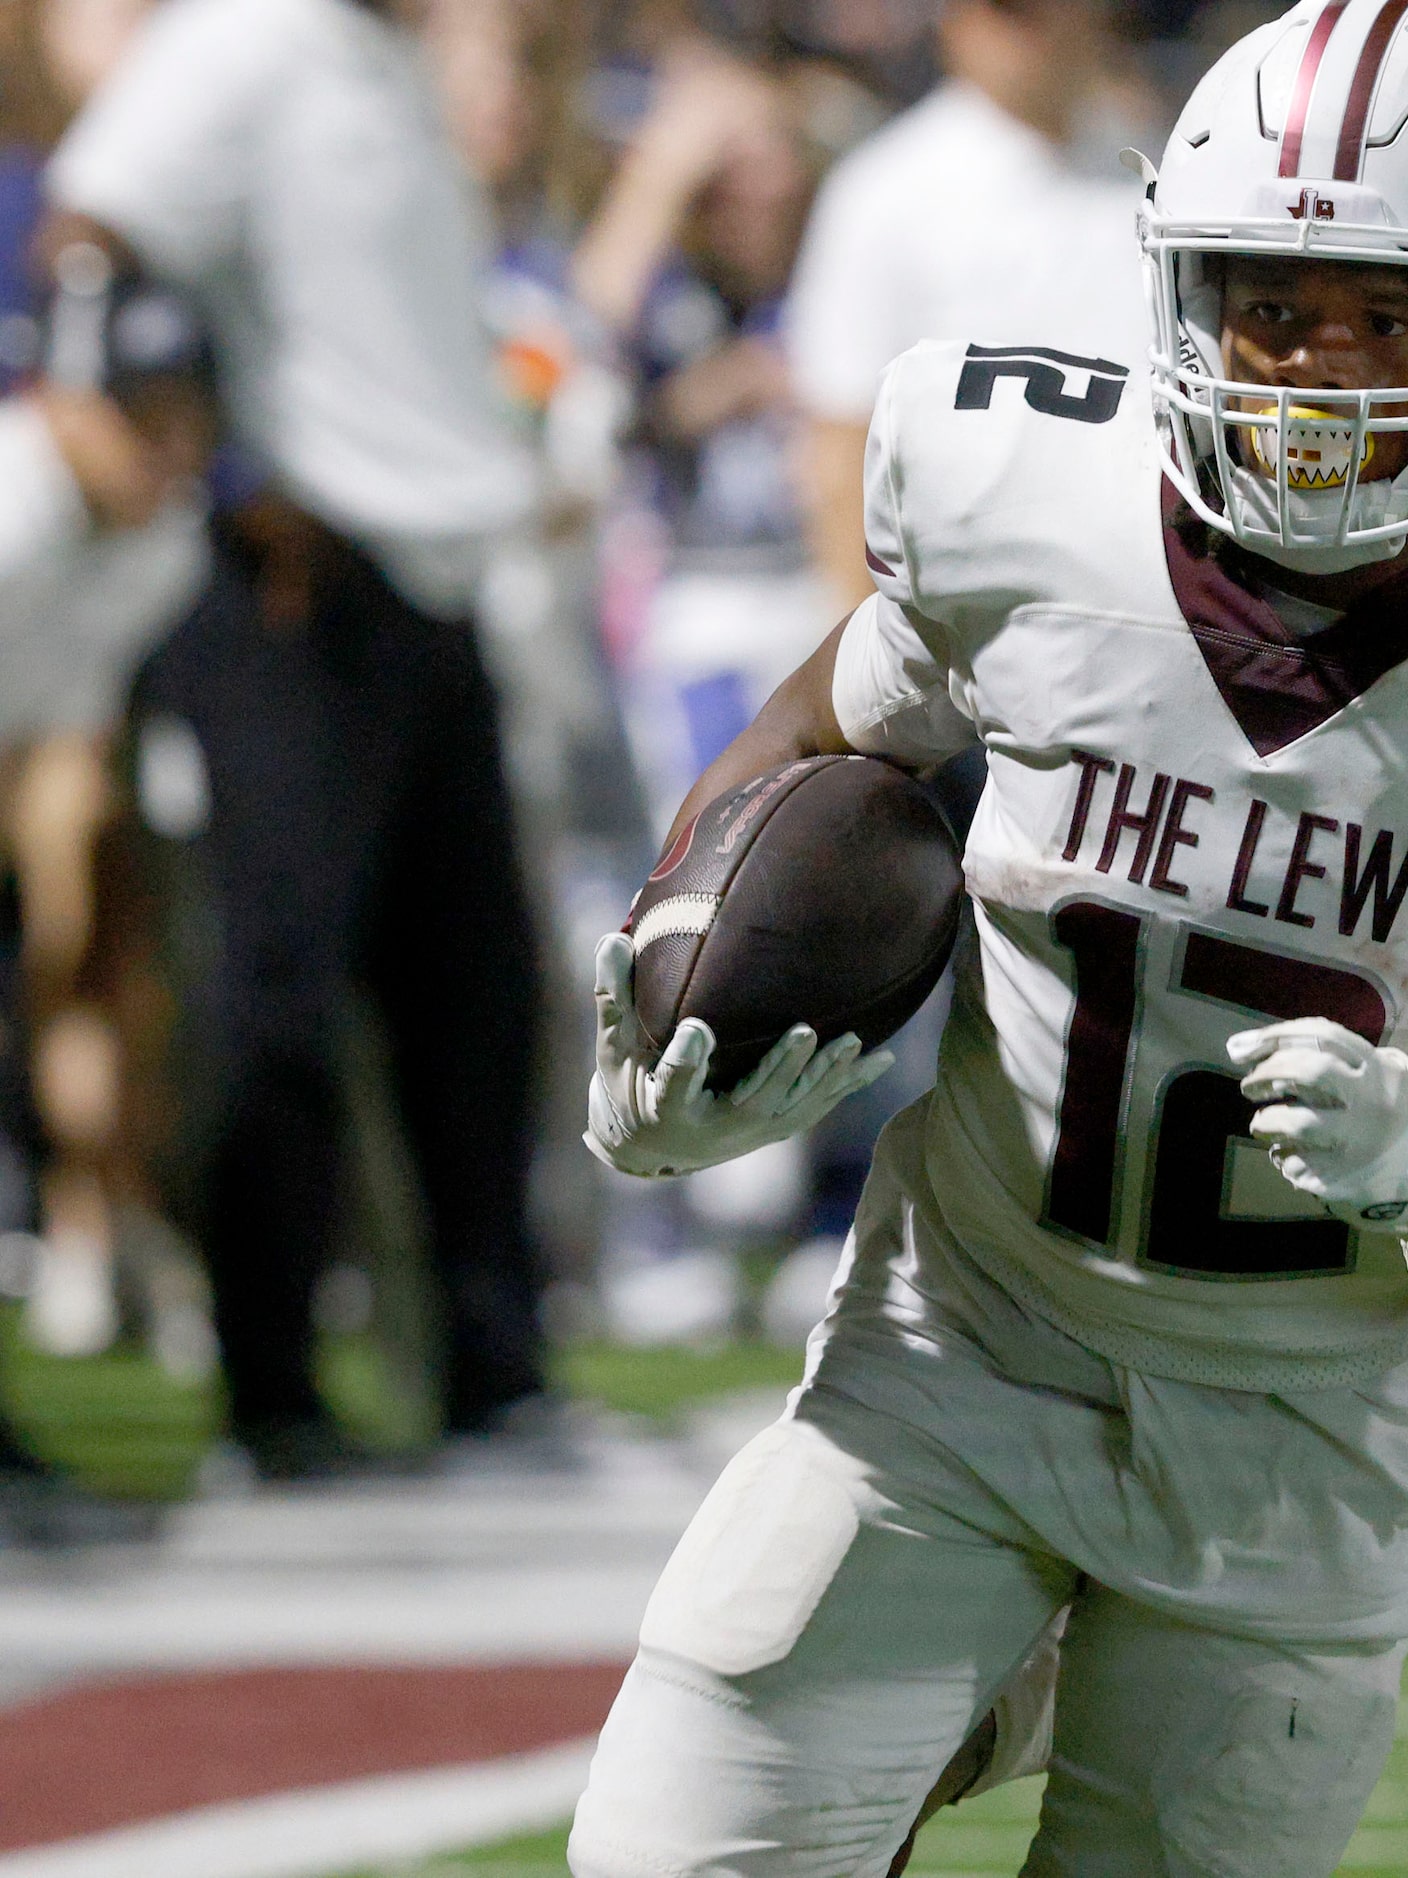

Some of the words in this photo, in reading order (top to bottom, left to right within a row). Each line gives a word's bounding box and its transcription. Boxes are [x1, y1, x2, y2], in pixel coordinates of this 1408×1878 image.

[954, 343, 1130, 423] 12
[1061, 750, 1214, 896] THE
[1038, 891, 1398, 1282] 12
